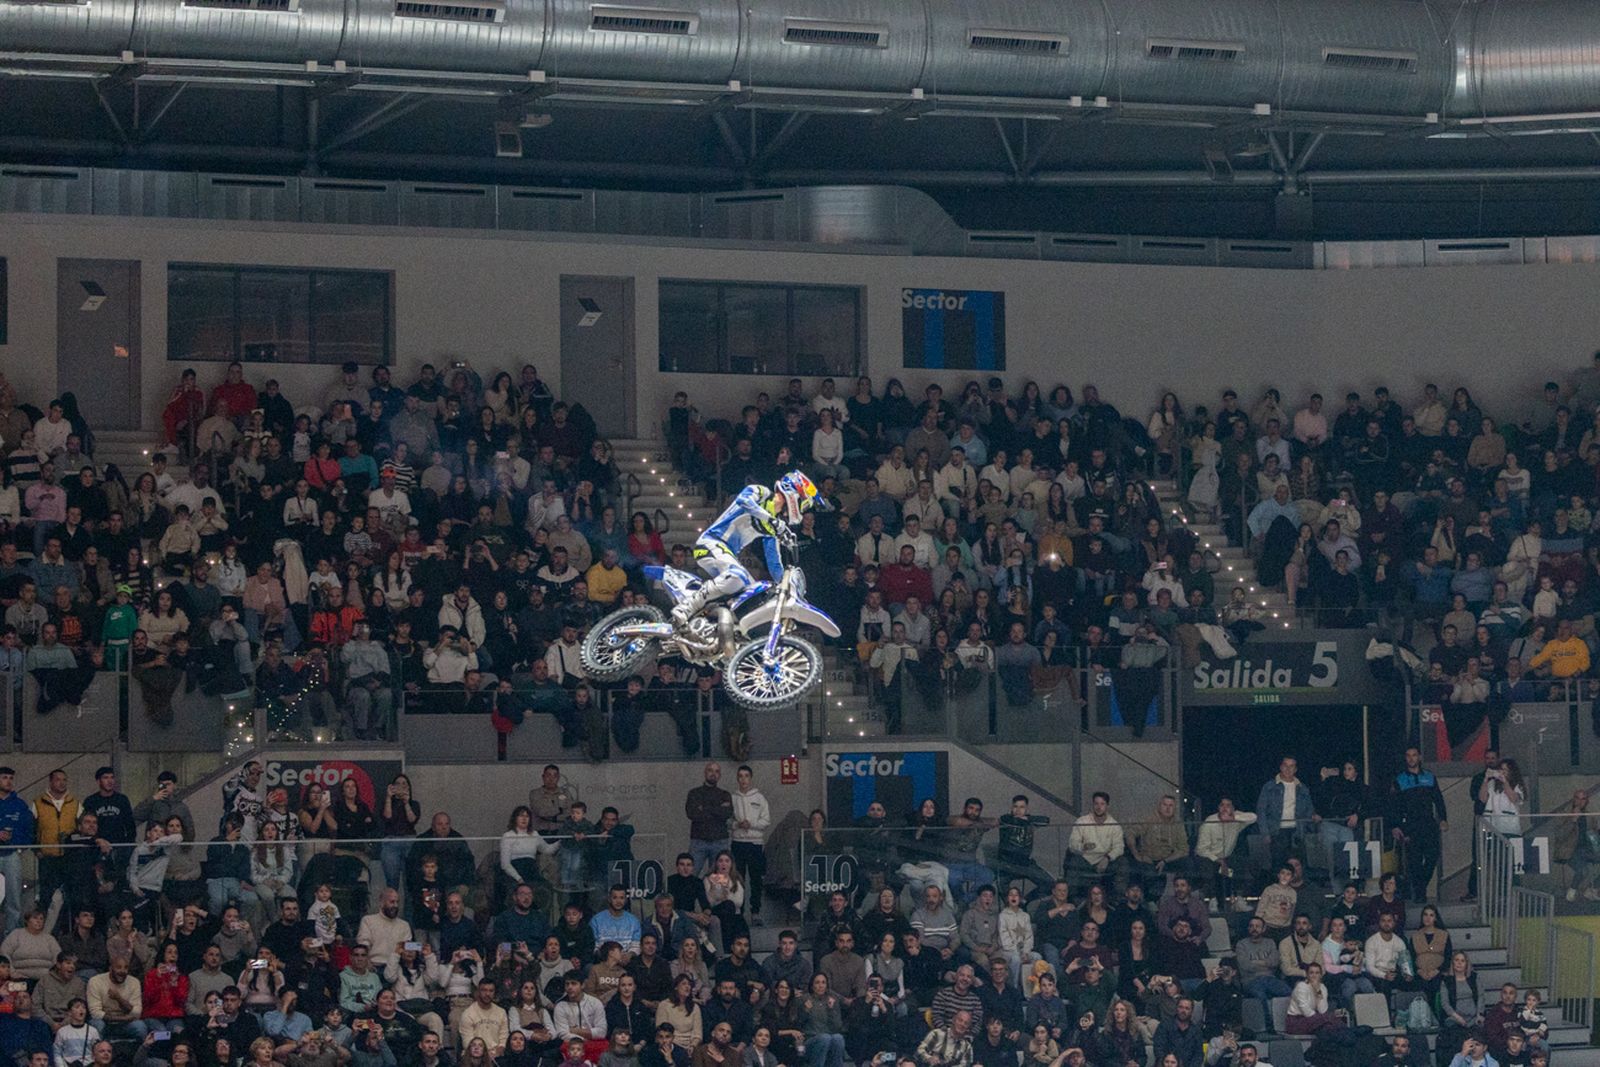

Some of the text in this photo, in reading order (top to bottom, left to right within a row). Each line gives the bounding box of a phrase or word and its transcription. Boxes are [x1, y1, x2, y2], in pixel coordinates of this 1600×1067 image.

[902, 289, 967, 310] Sector
[1193, 641, 1338, 689] Salida 5
[1254, 694, 1280, 703] SALIDA
[267, 762, 353, 786] Sector
[826, 754, 904, 776] Sector
[1342, 840, 1381, 879] 11
[1507, 836, 1550, 875] 11
[612, 859, 665, 900] 10
[805, 880, 845, 893] Sector
[809, 854, 860, 898] 10
